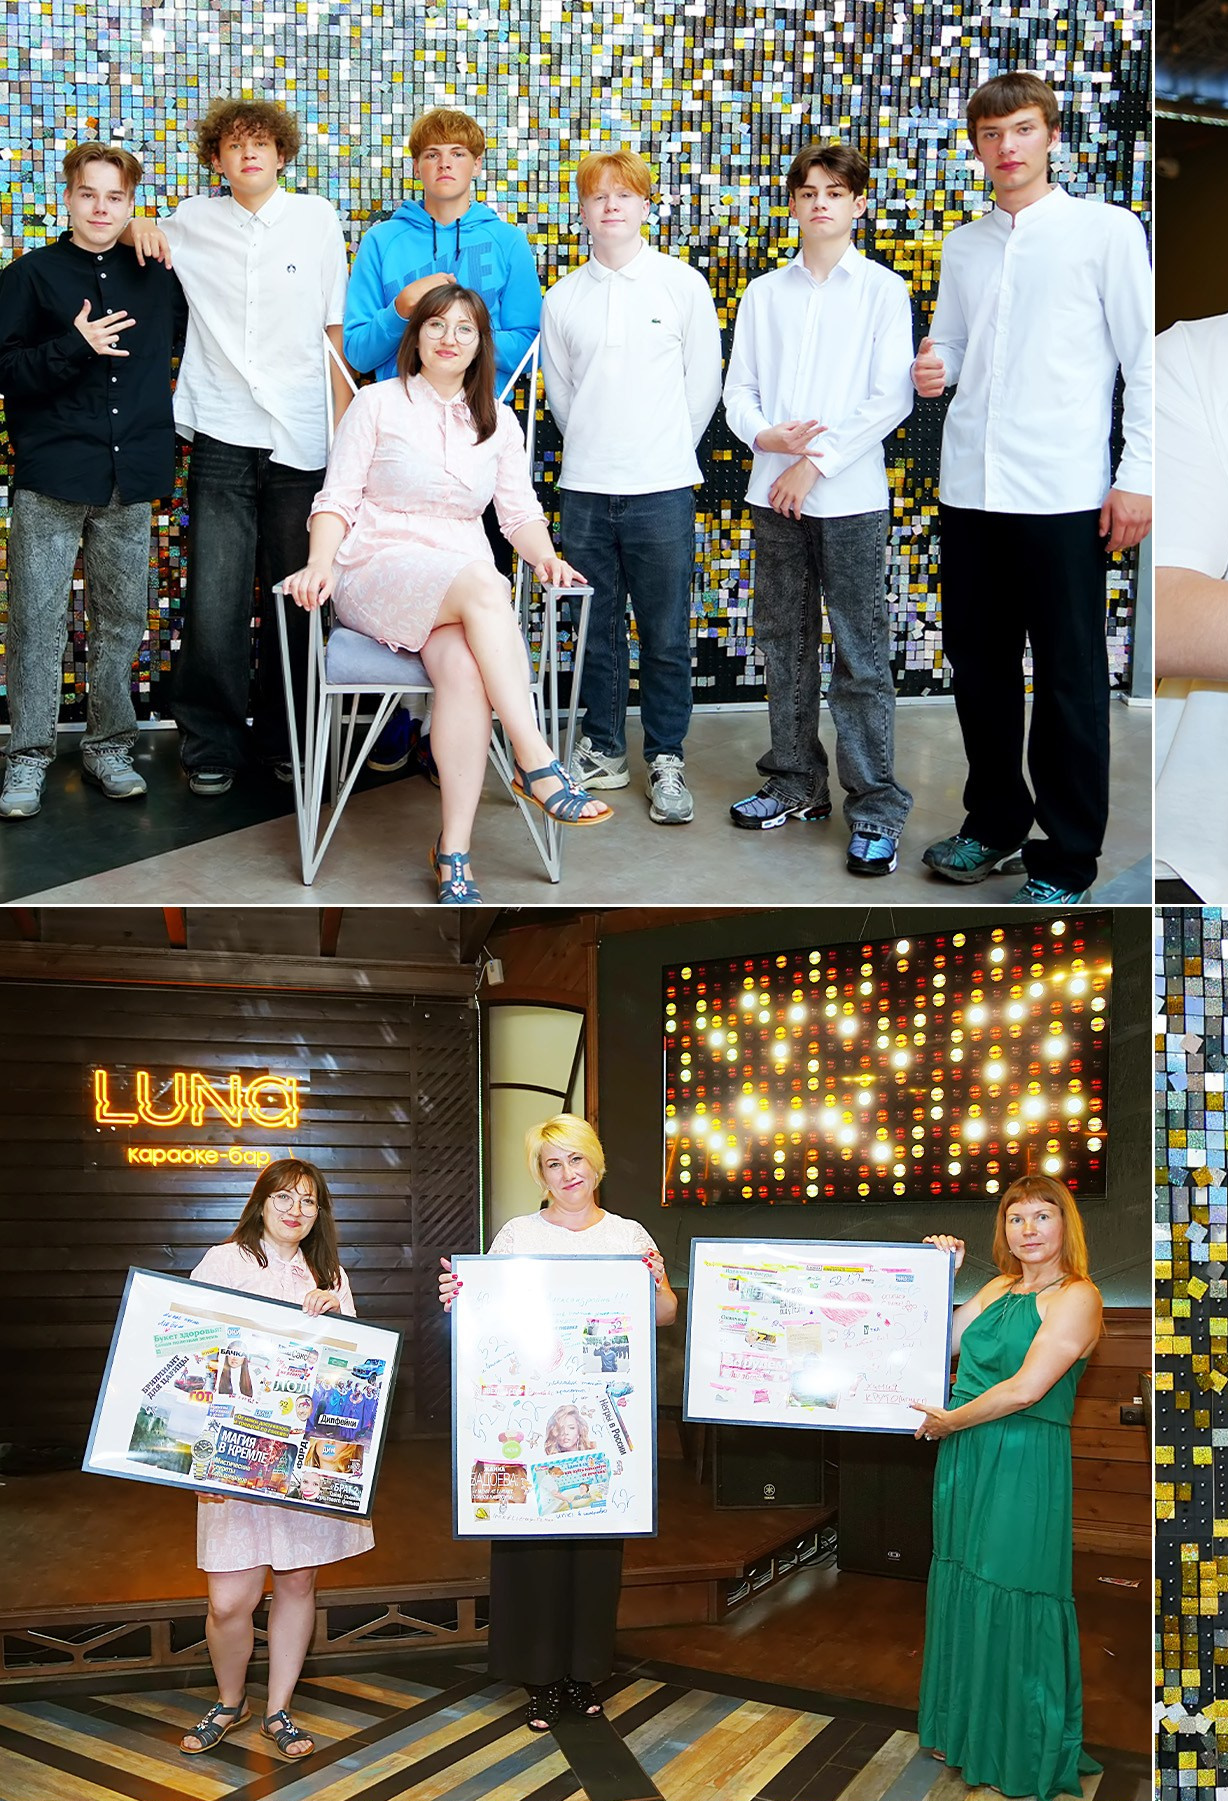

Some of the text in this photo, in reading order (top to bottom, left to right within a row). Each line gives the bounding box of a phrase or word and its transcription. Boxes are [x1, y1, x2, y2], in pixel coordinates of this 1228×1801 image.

[127, 1147, 271, 1168] караоке-бар
[320, 1414, 357, 1427] Дипфейки
[599, 1398, 613, 1422] Негры
[221, 1429, 257, 1448] МАГИЯ
[219, 1442, 268, 1464] В КРЕМЛЕ
[296, 1441, 309, 1469] ФОРД
